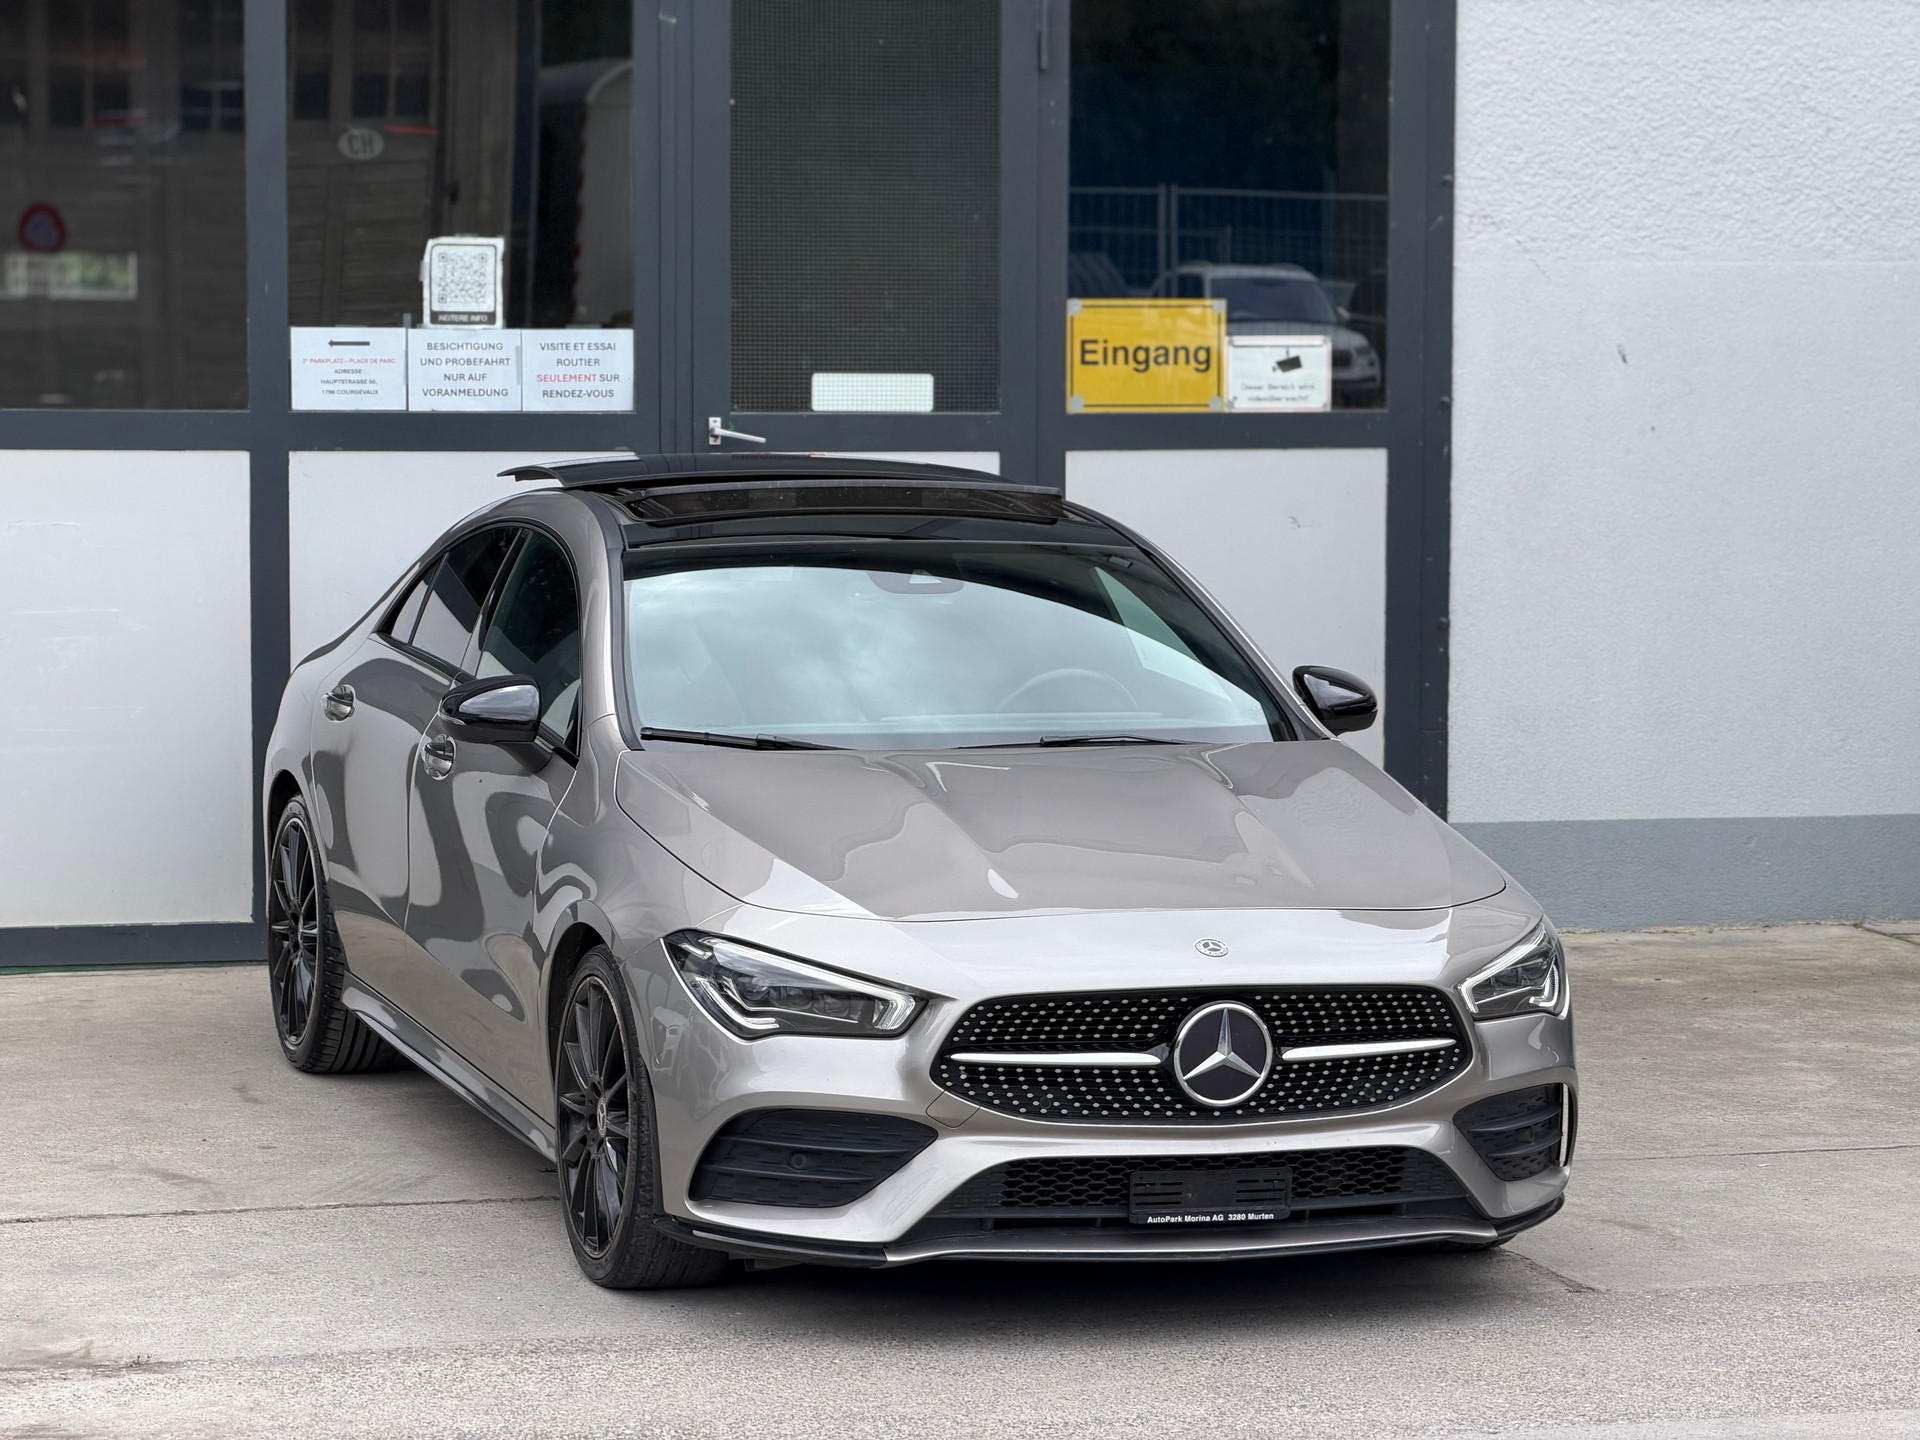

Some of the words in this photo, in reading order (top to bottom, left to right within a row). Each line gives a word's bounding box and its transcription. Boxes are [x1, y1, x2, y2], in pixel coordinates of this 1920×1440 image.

[427, 342, 503, 351] BESICHTIGUNG
[539, 342, 571, 351] VISITE
[573, 342, 585, 351] ET
[587, 342, 616, 351] ESSAI
[1080, 339, 1211, 373] Eingang
[420, 358, 442, 366] UND
[445, 358, 511, 366] PROBEFAHRT
[556, 358, 600, 367] ROUTIER
[443, 373, 466, 381] NUR
[467, 373, 488, 381] AUF
[536, 374, 597, 383] SEULEMENT
[598, 374, 620, 383] SUR
[422, 388, 509, 397] VORANMELDUNG
[542, 389, 615, 398] RENDEZ-VOUS
[1147, 1215, 1183, 1223] AutoPark
[1184, 1214, 1211, 1222] Morina
[1227, 1213, 1246, 1221] 3280
[1247, 1212, 1274, 1220] Murten
